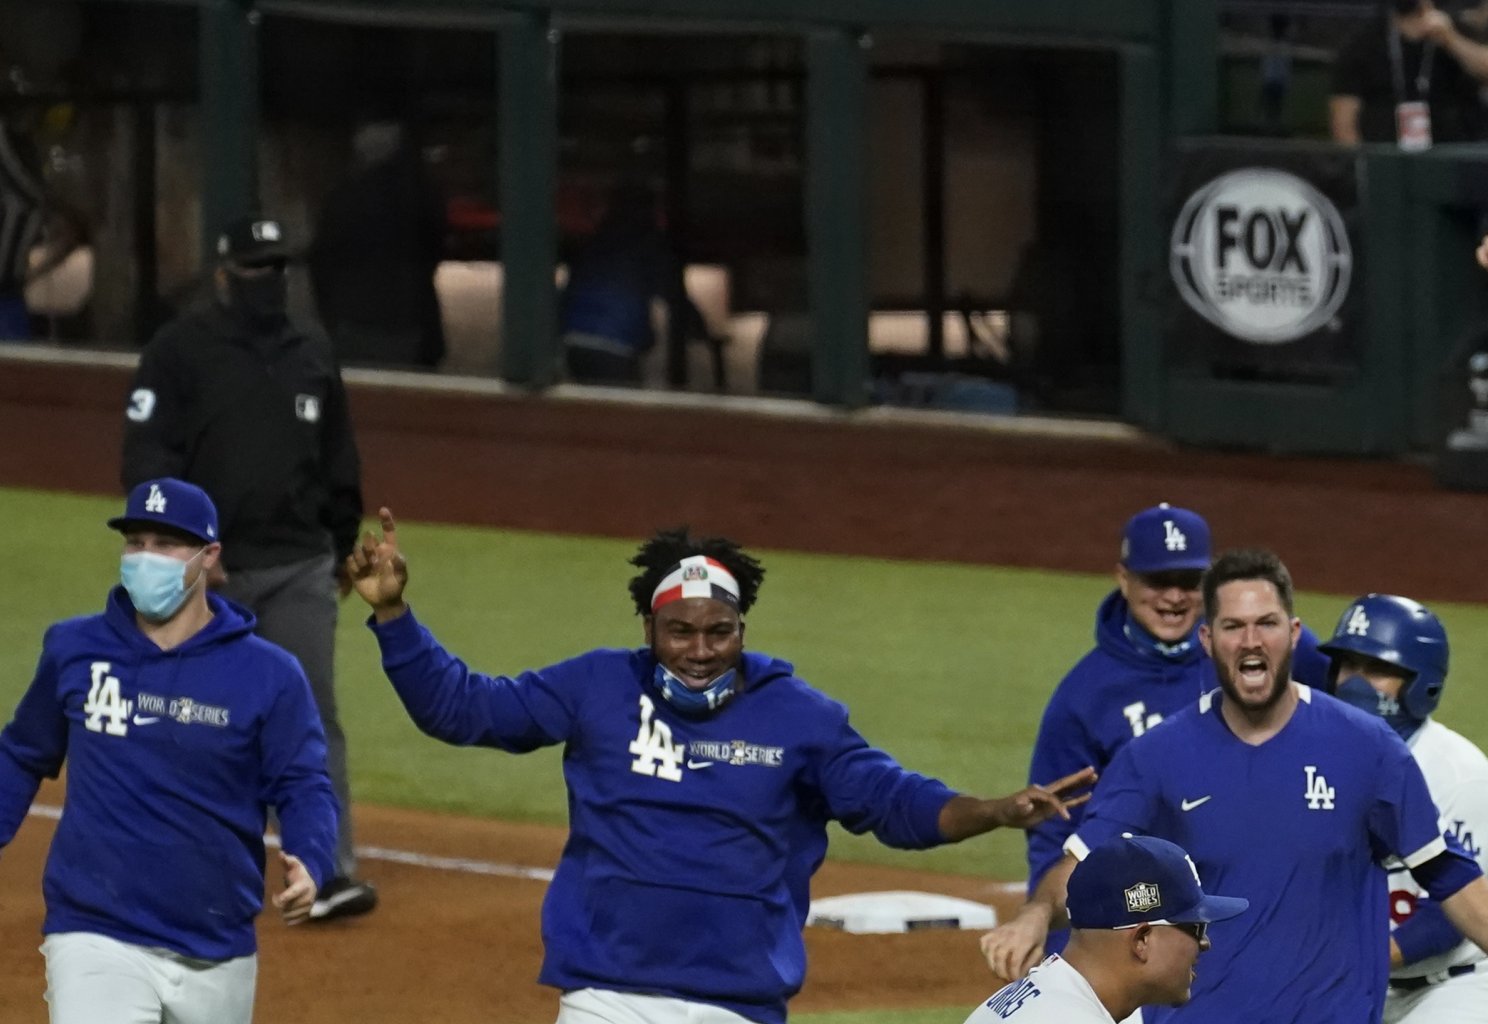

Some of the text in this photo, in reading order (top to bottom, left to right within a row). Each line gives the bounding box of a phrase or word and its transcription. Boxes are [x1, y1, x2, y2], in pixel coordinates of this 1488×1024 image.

[1217, 207, 1307, 273] FOX
[145, 483, 168, 514] LA
[1162, 520, 1188, 551] LA
[1346, 604, 1371, 637] LA
[84, 661, 133, 737] LA
[629, 693, 685, 782] LA
[689, 740, 731, 762] WORLD
[745, 746, 785, 767] SERIES
[1304, 765, 1336, 810] LA
[1128, 886, 1157, 901] WORLD
[1129, 895, 1158, 909] SERIES
